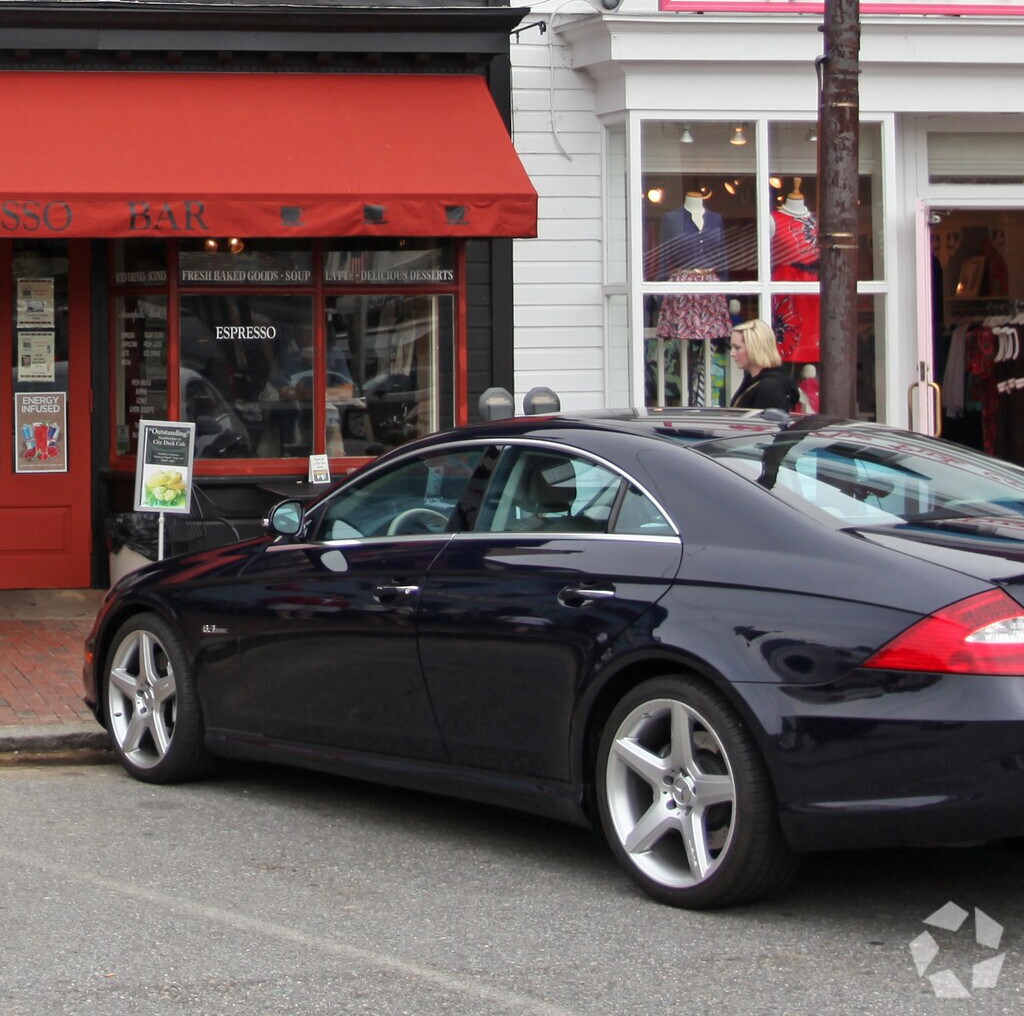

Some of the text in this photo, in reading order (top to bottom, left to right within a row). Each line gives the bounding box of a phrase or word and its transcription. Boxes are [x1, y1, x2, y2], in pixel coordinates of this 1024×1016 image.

[128, 200, 209, 231] BAR
[181, 270, 311, 281] FRESH BAKED GOODS SOUP
[360, 269, 407, 281] DELICIOUS
[409, 269, 453, 281] DESSERTS
[215, 326, 277, 340] ESPRESSO
[22, 396, 59, 405] ENERGY
[21, 405, 60, 414] INFUSED
